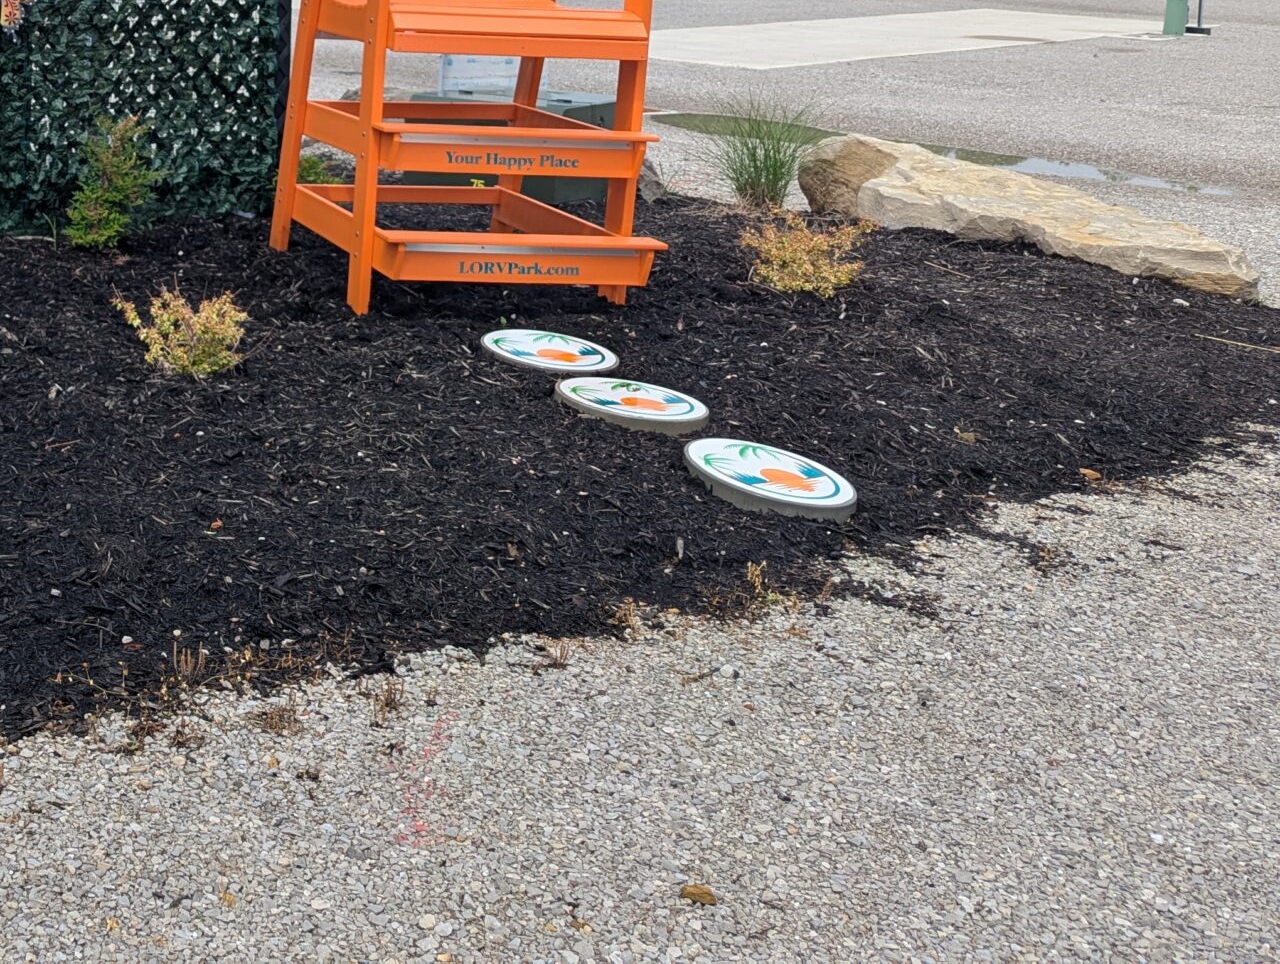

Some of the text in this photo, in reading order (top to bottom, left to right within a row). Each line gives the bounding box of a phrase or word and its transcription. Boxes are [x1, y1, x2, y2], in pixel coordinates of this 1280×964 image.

[445, 150, 580, 171] Your Happy Place
[458, 260, 580, 277] LORVPark.com
